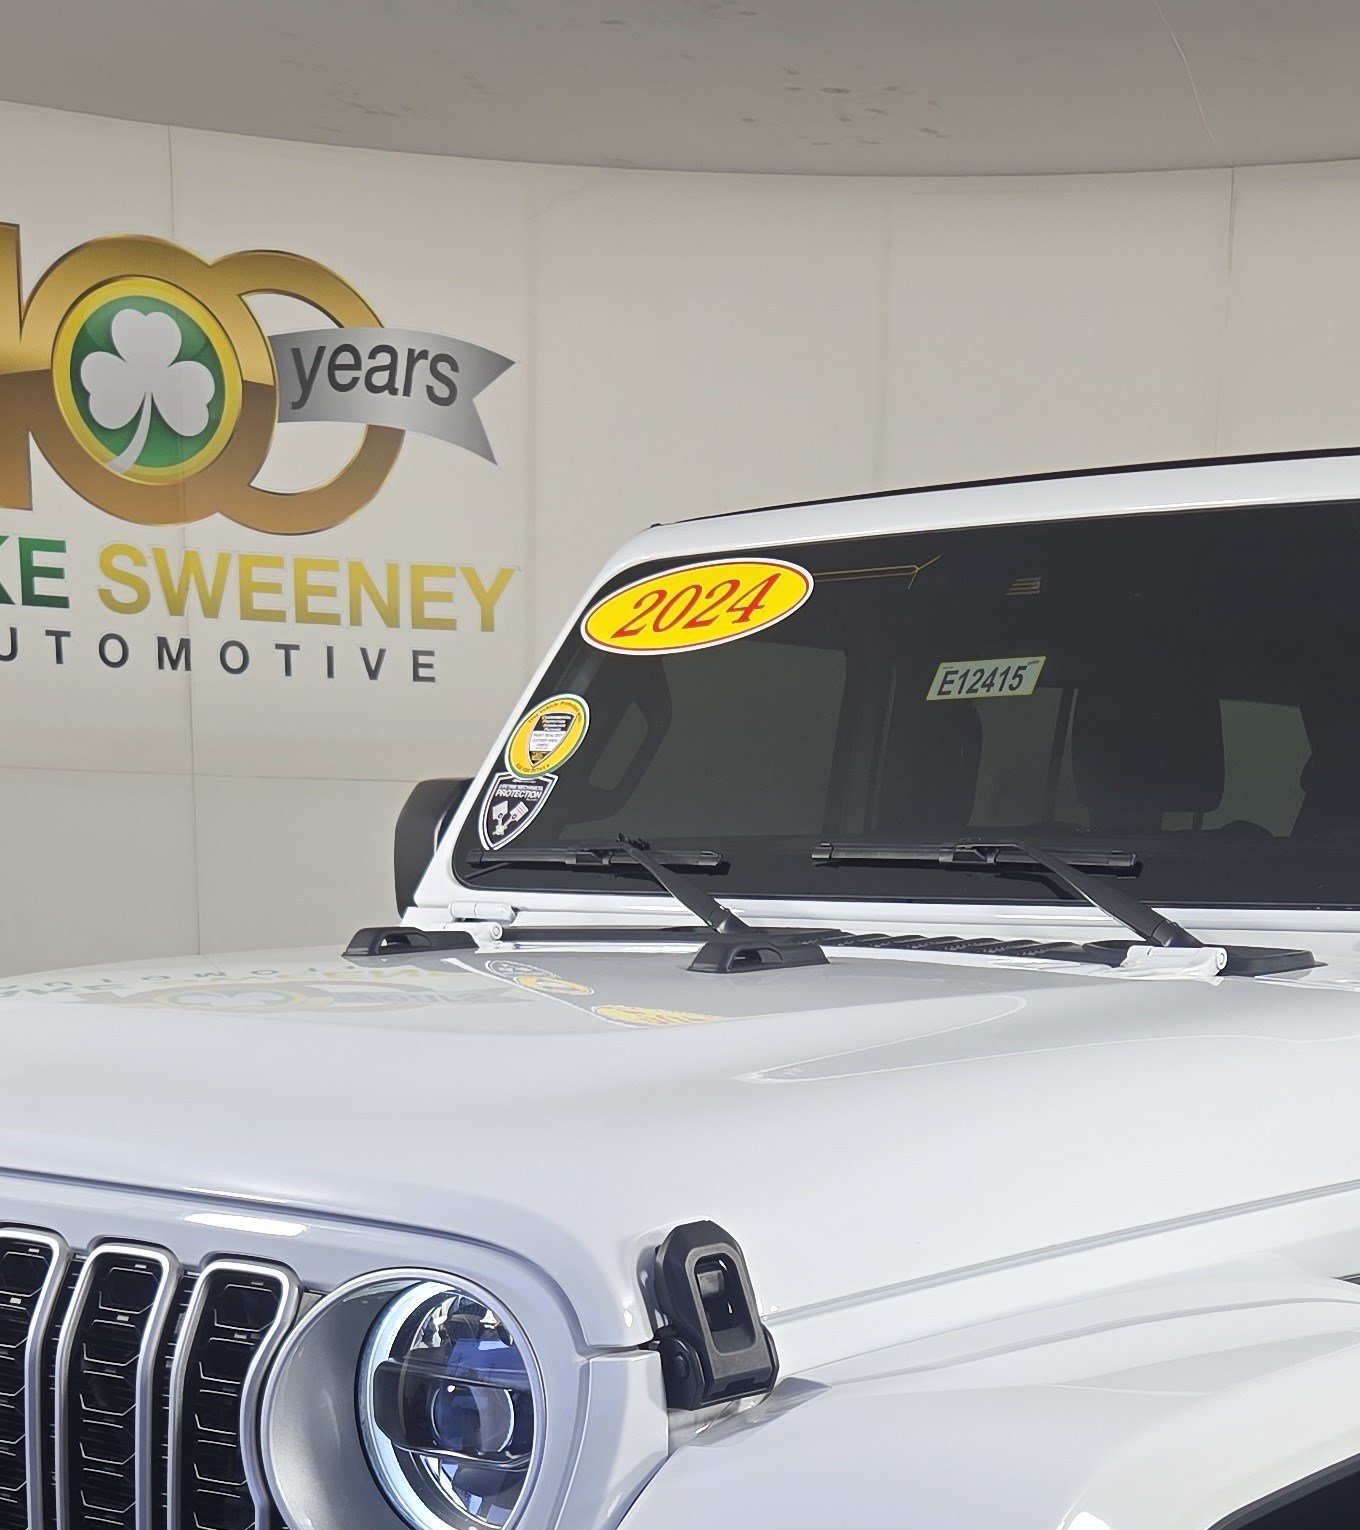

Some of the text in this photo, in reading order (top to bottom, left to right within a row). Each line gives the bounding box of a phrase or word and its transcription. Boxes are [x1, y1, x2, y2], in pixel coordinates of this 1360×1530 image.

[290, 342, 461, 410] years
[97, 542, 516, 632] SWEENEY
[611, 573, 781, 639] 2024
[937, 665, 1028, 696] E12415
[495, 788, 543, 799] PROTECTION
